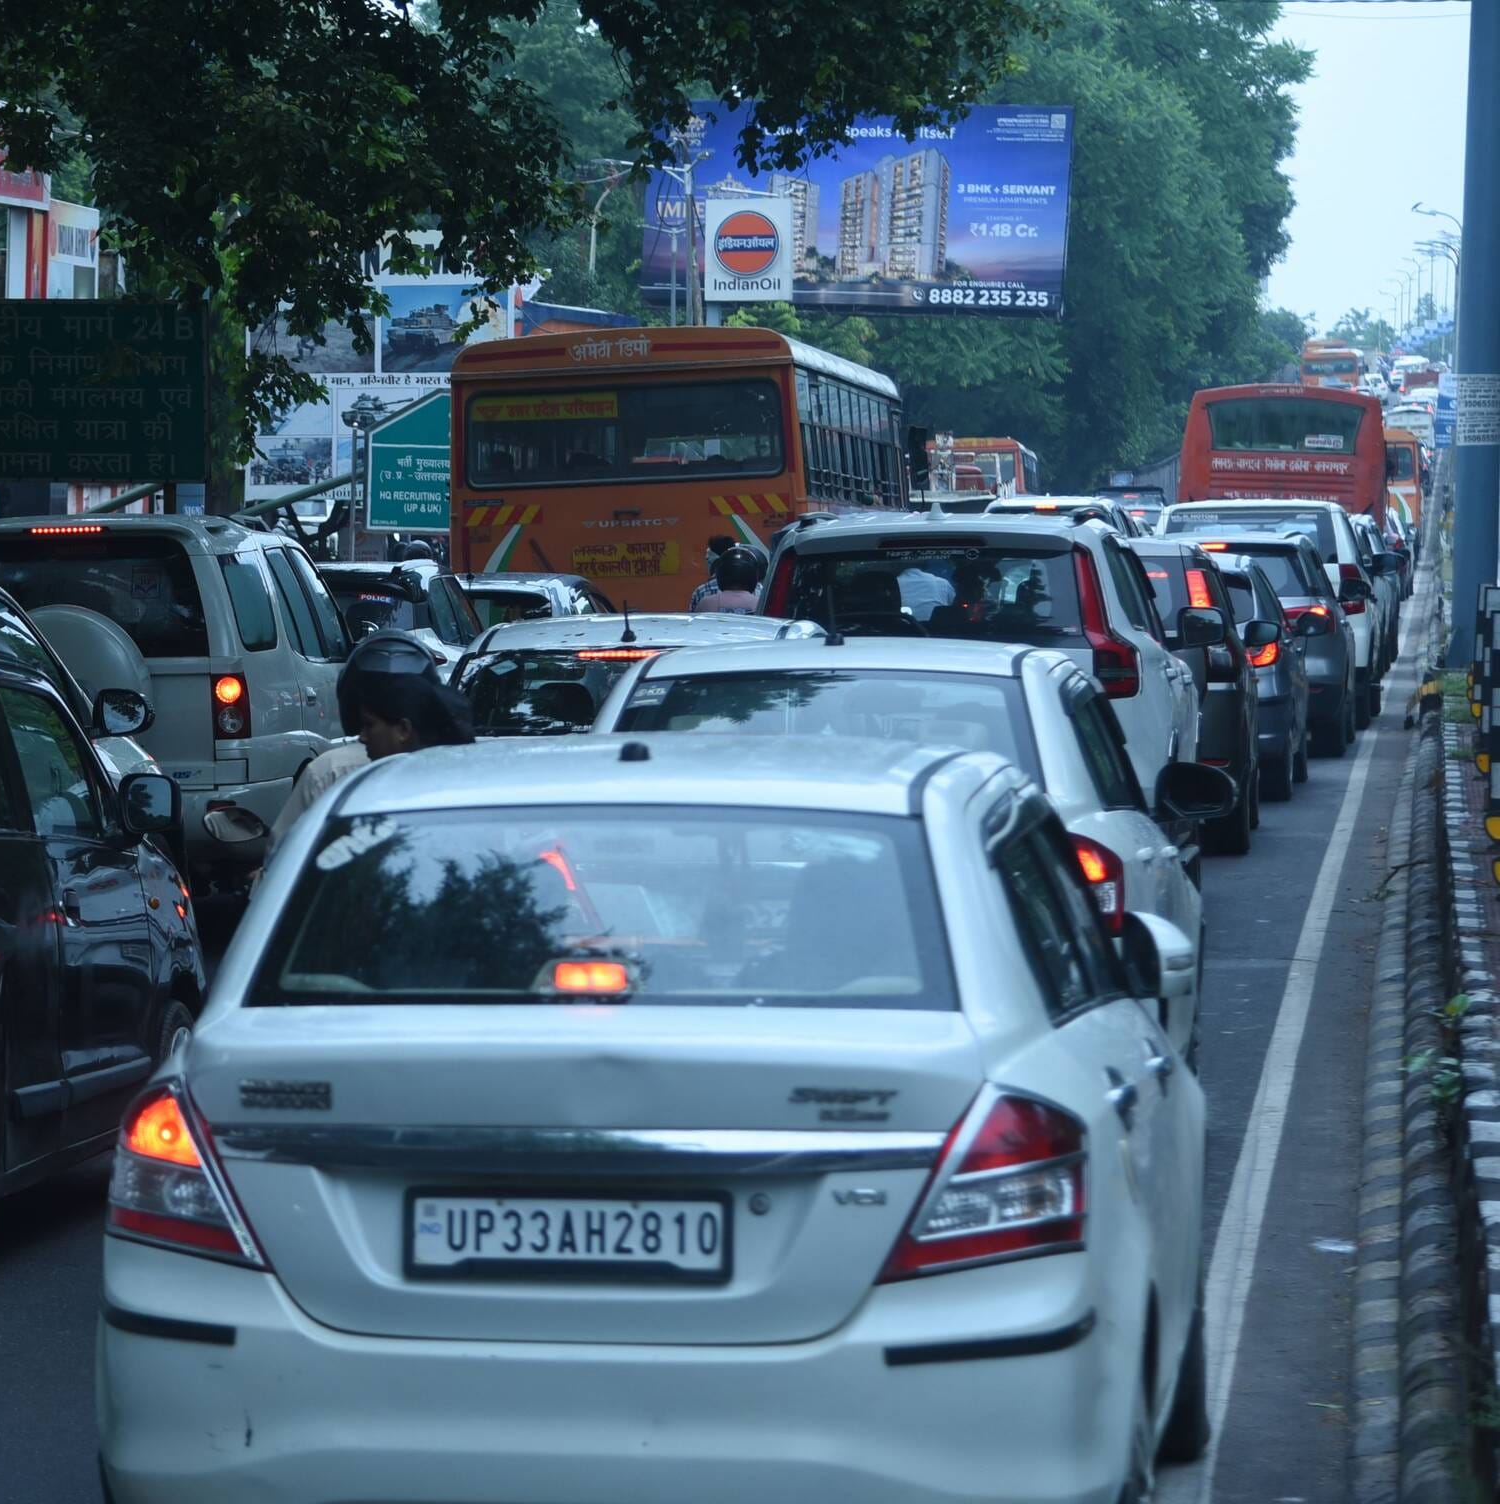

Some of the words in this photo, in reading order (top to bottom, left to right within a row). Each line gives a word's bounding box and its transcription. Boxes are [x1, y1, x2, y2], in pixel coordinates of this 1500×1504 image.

[957, 184, 965, 193] 3
[967, 184, 992, 194] BHK
[1003, 184, 1056, 195] SERVANT
[964, 196, 998, 204] PREMIUM
[1000, 197, 1048, 205] APARTMENTS
[718, 236, 775, 250] इंडियनऑयल
[714, 278, 780, 291] IndianOil
[928, 287, 975, 304] 8882
[978, 288, 1012, 306] 235
[1015, 289, 1048, 307] 235
[61, 306, 116, 340] मार्ग
[132, 315, 165, 340] 24
[174, 315, 194, 340] B
[615, 334, 651, 358] डिपो
[415, 375, 441, 386] भारत
[48, 384, 146, 409] मंगलमय
[158, 384, 193, 412] एवं
[73, 419, 129, 440] यात्रा
[140, 413, 172, 440] की
[68, 453, 132, 474] करता
[380, 491, 391, 500] HQ
[393, 491, 441, 501] RECRUITING
[404, 503, 418, 513] (UP
[598, 518, 662, 528] UPSRTC
[361, 593, 392, 603] POLICE
[446, 1207, 718, 1256] UP33AH2810
